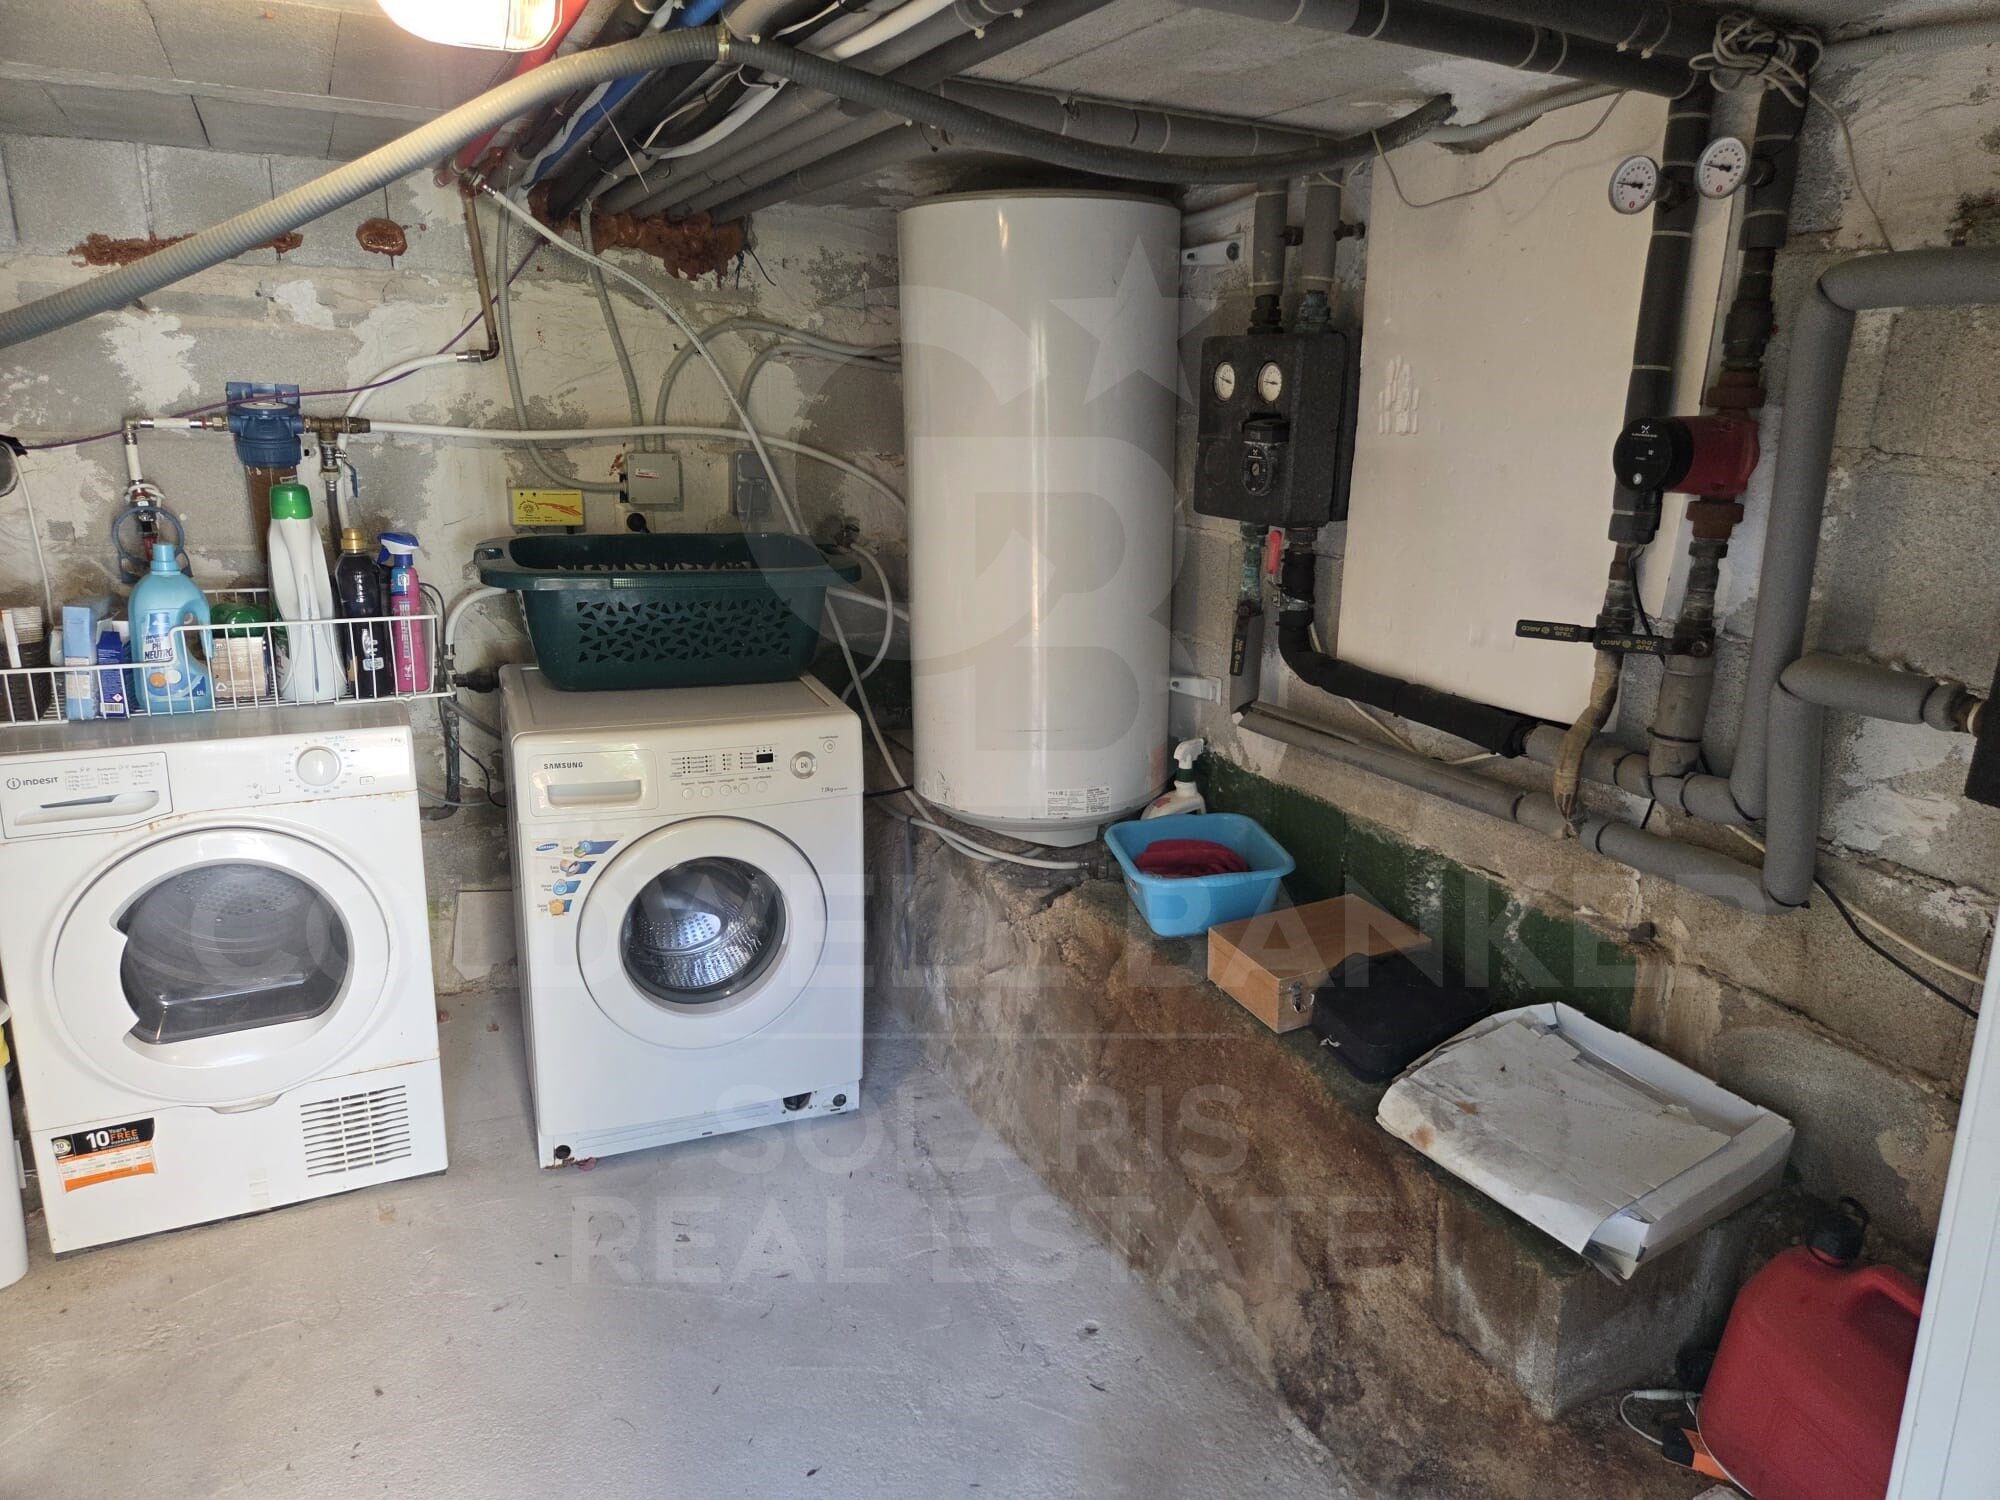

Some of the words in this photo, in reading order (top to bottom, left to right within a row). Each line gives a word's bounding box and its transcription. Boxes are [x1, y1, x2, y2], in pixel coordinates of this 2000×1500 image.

[543, 761, 584, 770] SAMSUNG
[86, 1130, 110, 1148] 10
[110, 1128, 139, 1141] FREE
